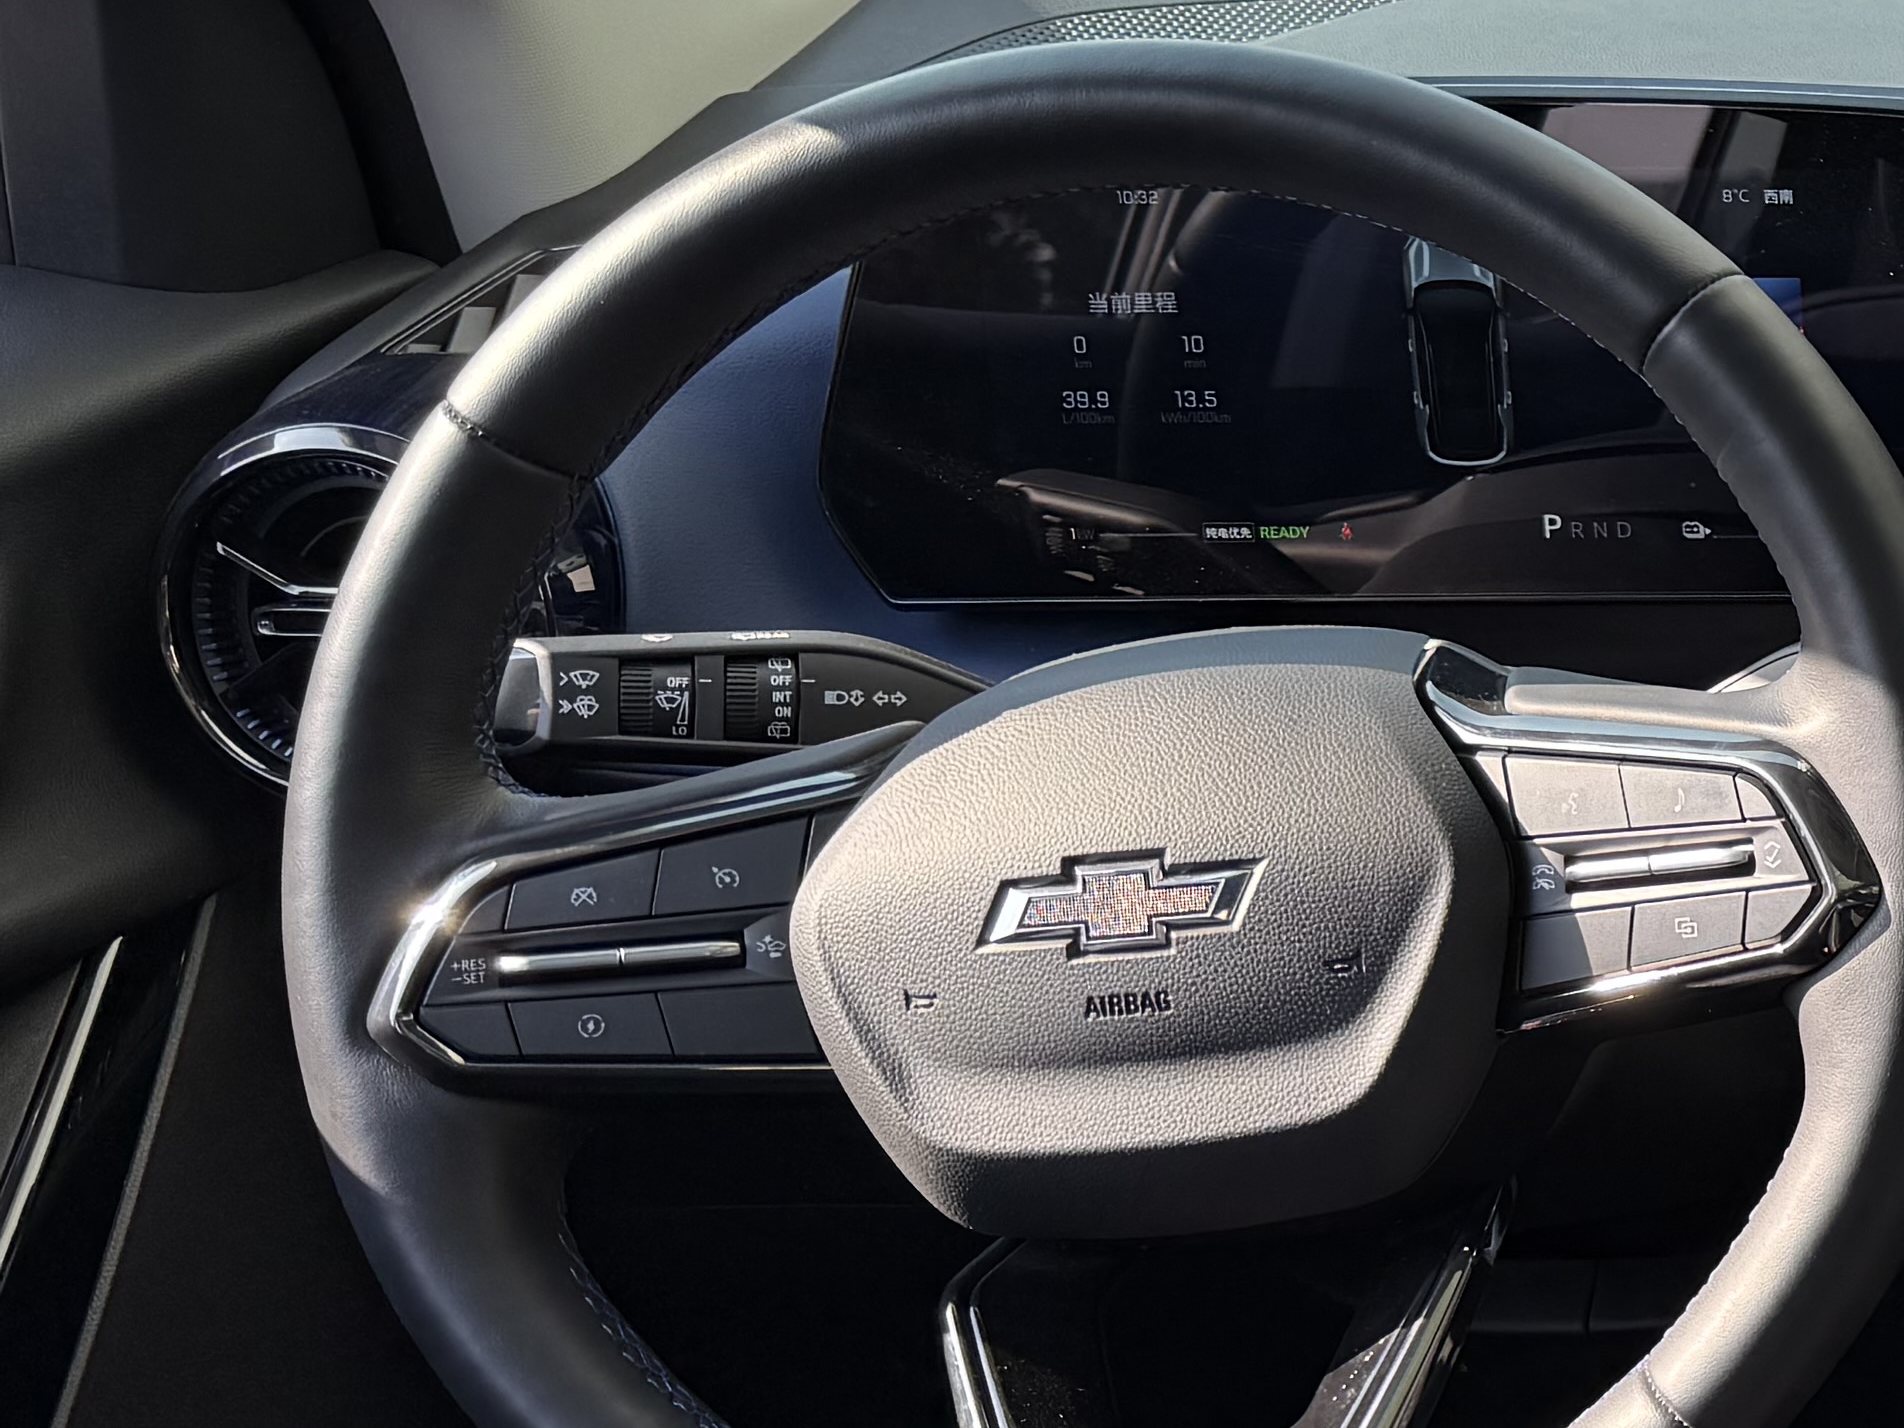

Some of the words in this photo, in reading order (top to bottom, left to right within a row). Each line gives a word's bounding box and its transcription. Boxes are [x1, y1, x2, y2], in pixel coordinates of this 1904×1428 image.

[1116, 190, 1160, 205] 10:32
[1722, 188, 1750, 203] 8°C
[1763, 188, 1794, 205] 西南
[1088, 291, 1179, 315] 当前里程
[1073, 335, 1087, 354] 0
[1180, 334, 1205, 354] 10
[1074, 357, 1093, 370] km
[1183, 357, 1207, 369] min
[1061, 390, 1110, 409] 39.9
[1173, 389, 1218, 408] 13.5
[1205, 526, 1253, 540] 纯电优先
[1259, 525, 1310, 540] READY
[1541, 514, 1563, 539] P
[1570, 521, 1586, 539] R
[1593, 521, 1609, 539] N
[1617, 521, 1633, 539] D
[666, 676, 691, 688] OFF
[770, 675, 793, 686] OFF
[772, 690, 793, 703] INT
[775, 706, 792, 718] ON
[672, 726, 688, 736] LO
[451, 959, 487, 972] +RES
[451, 972, 486, 985] -SET
[1083, 988, 1173, 1020] AIRBAG
